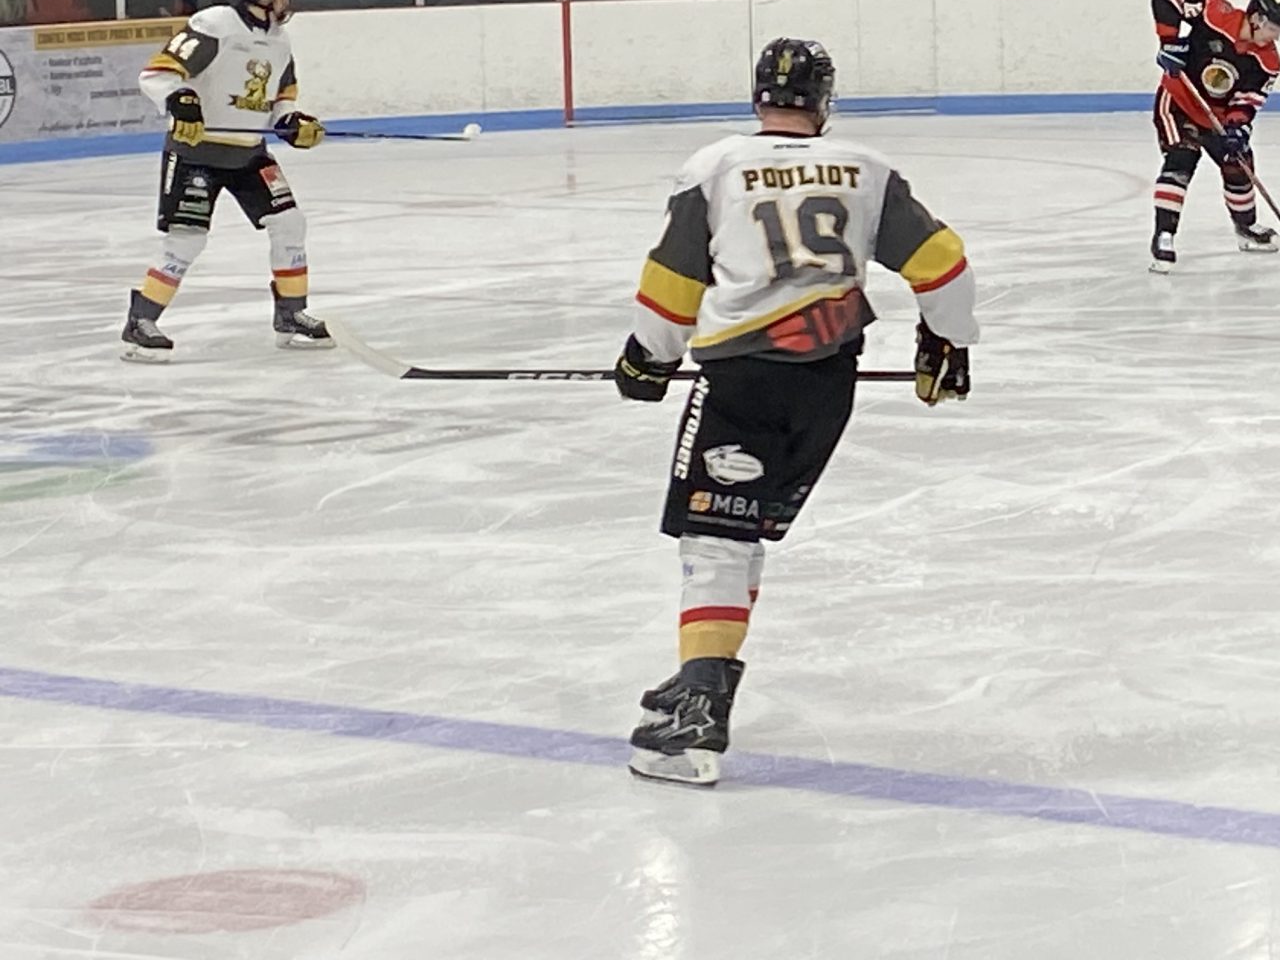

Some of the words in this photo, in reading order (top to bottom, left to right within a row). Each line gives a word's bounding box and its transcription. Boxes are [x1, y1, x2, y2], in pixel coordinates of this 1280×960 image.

[742, 164, 860, 191] POULIOT
[752, 196, 857, 282] 19
[712, 494, 761, 519] MBA
